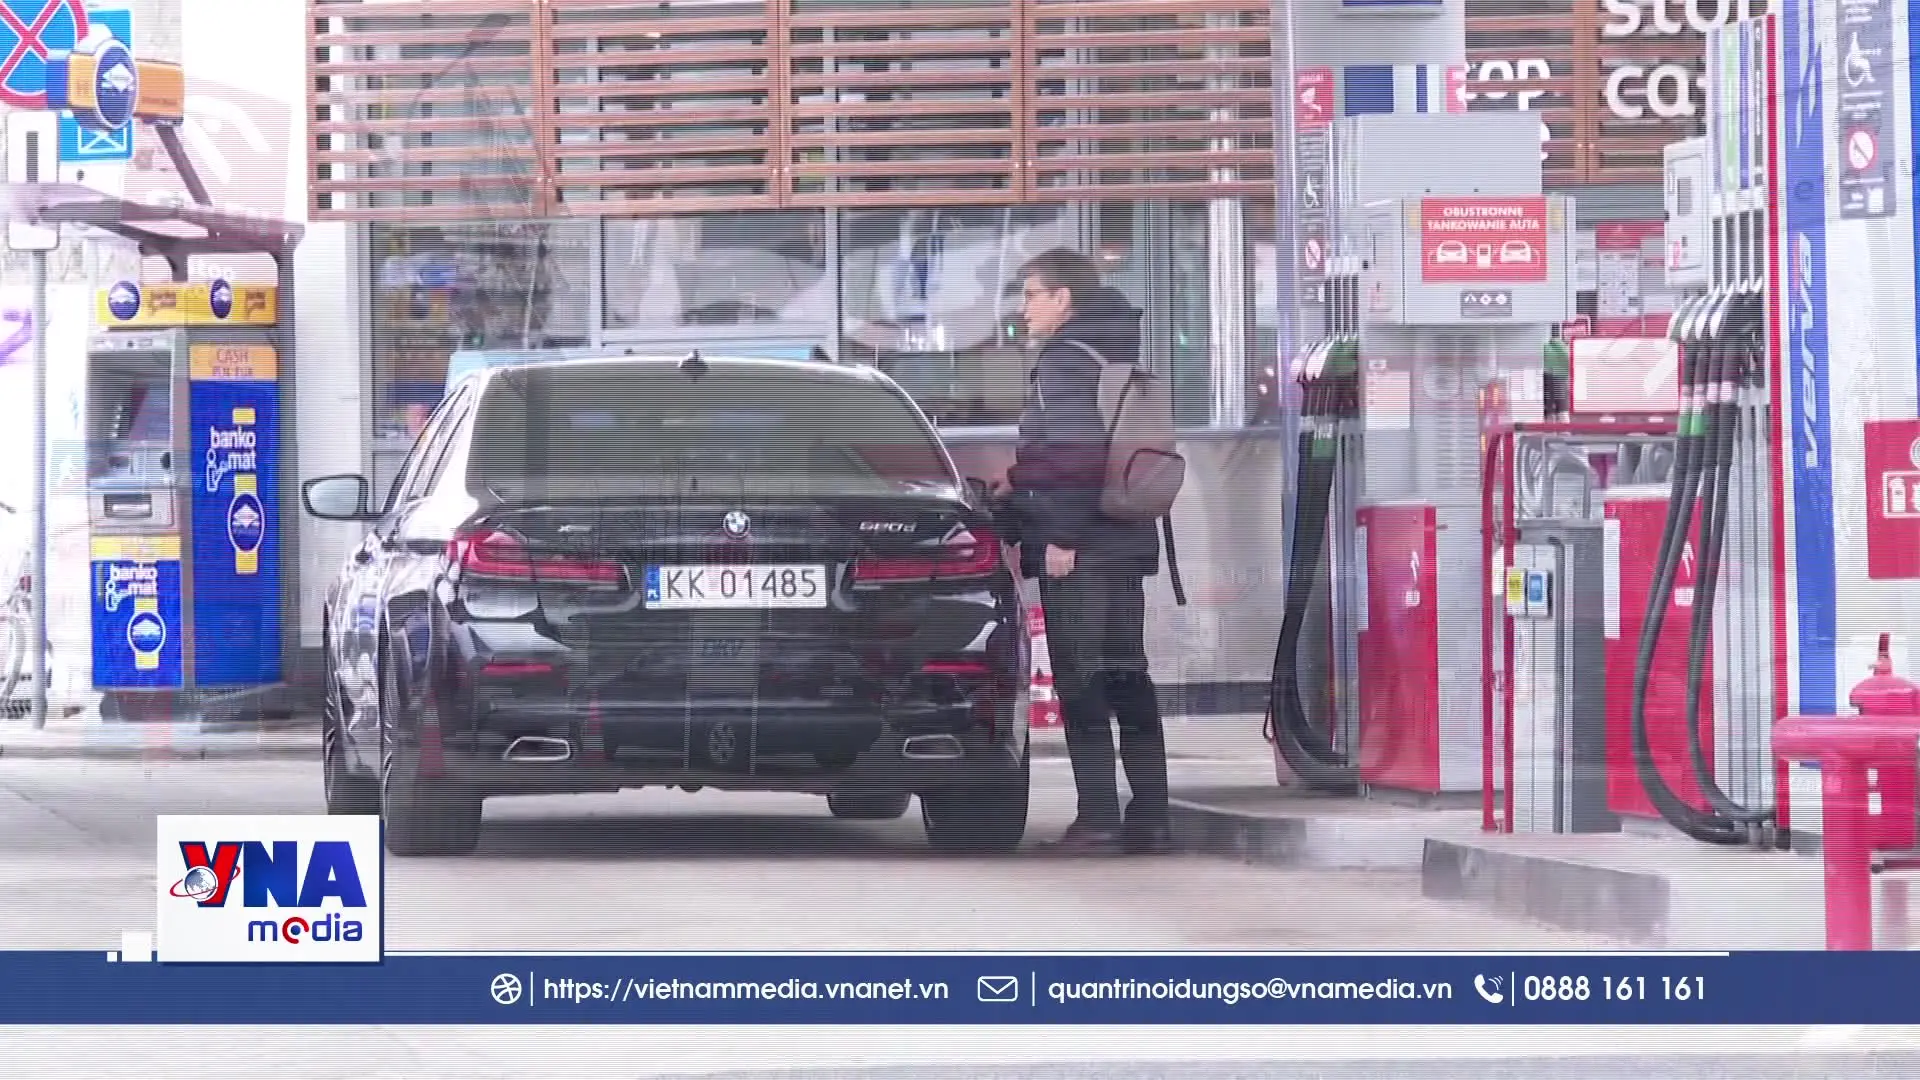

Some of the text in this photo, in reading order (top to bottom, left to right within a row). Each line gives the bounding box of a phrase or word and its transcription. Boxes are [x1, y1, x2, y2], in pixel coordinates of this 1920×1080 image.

[1606, 65, 1707, 118] ca
[1443, 206, 1524, 218] OBUSTRONNE
[1427, 219, 1540, 232] TANKOWANIE AUTA
[216, 350, 249, 363] CASH
[210, 426, 256, 448] banko
[228, 451, 256, 470] mat
[109, 562, 158, 581] banko
[127, 580, 158, 597] mat
[666, 568, 818, 600] KK 01485
